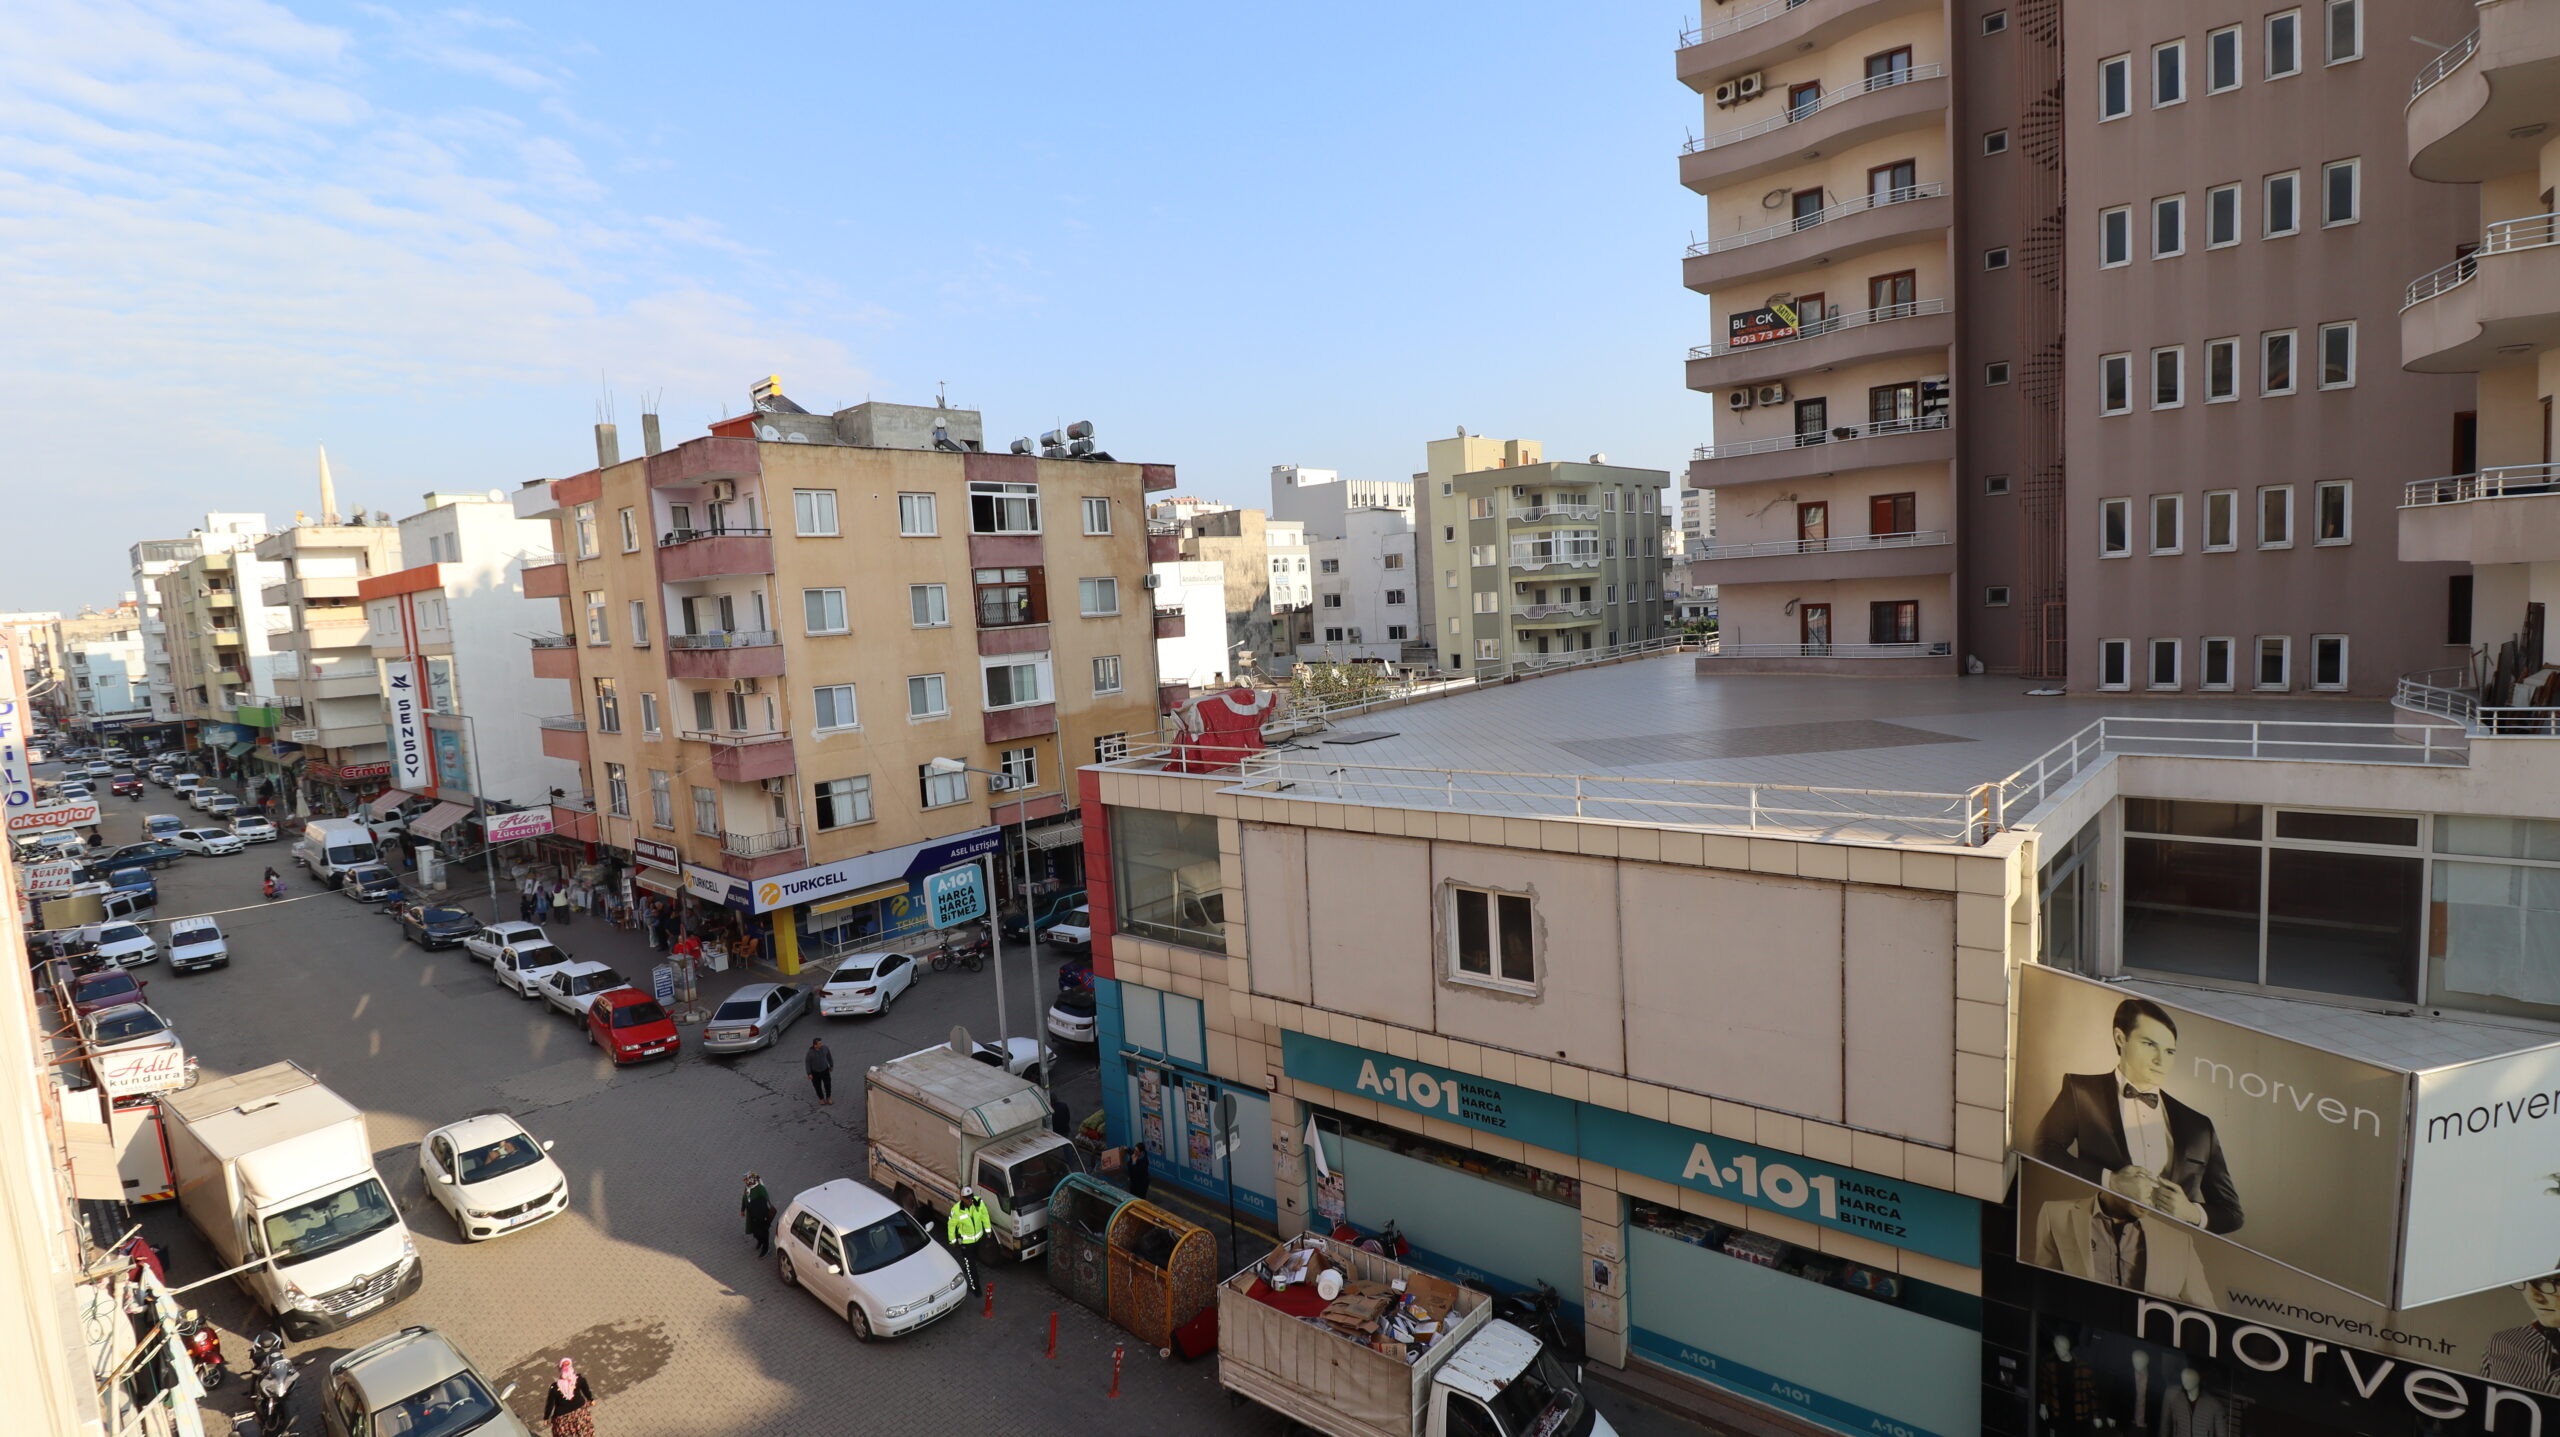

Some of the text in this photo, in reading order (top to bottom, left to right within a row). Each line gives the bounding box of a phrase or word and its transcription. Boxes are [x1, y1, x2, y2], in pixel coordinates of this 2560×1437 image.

[1733, 327, 1793, 346] 503 73 43
[9, 807, 95, 829] aksaylar
[951, 839, 999, 858] ASEL İLETİŞİM
[30, 878, 71, 889] BELLA
[691, 875, 720, 894] TURKCELL
[782, 871, 848, 896] TURKCELL
[938, 885, 975, 904] HARCA
[939, 894, 976, 914] HARCA
[108, 1052, 178, 1078] Adil
[109, 1072, 181, 1088] kundura
[1460, 1083, 1502, 1101] HARCA
[2194, 1055, 2381, 1137] morven
[1461, 1097, 1502, 1114] HARCA
[1839, 1179, 1902, 1204] HARCA
[1840, 1195, 1902, 1220] HARCA
[2228, 1290, 2457, 1356] www.morven.com.tr
[2136, 1297, 2542, 1437] morven
